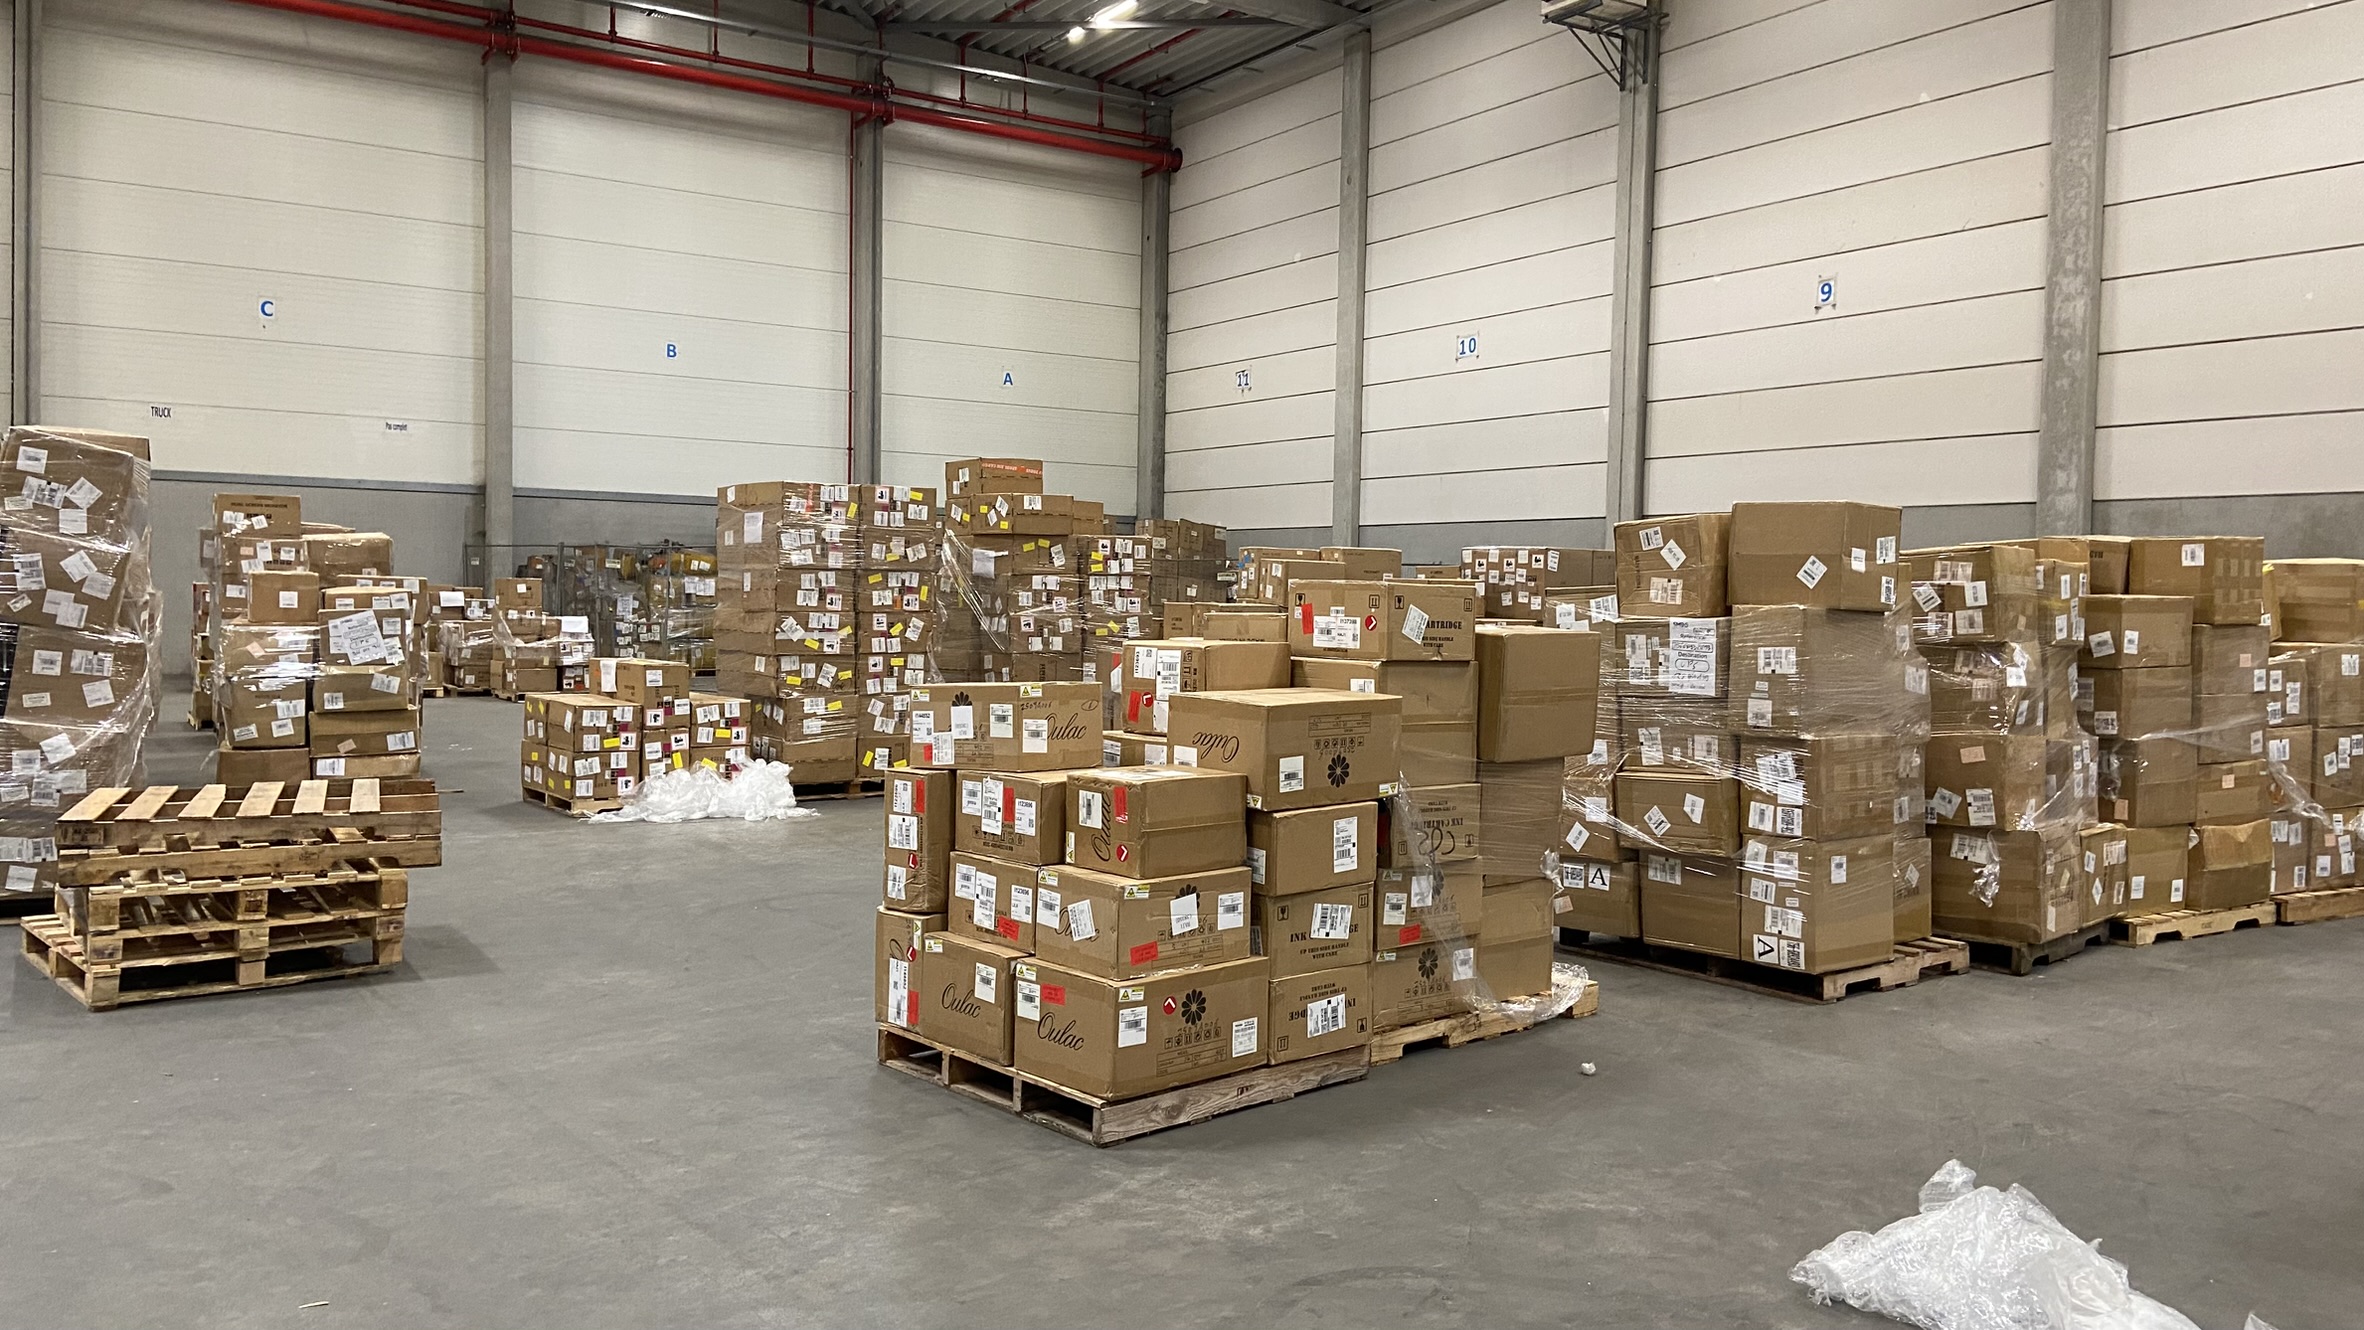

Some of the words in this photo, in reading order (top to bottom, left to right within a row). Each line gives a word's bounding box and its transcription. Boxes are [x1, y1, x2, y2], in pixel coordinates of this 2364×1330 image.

[1820, 282, 1833, 302] 9
[260, 300, 274, 317] C
[666, 343, 677, 358] B
[1459, 338, 1477, 355] 10
[1003, 372, 1014, 386] A
[1237, 373, 1250, 387] 11
[150, 406, 172, 418] TRUCK
[1425, 620, 1462, 629] ARTRIDGE
[1191, 731, 1240, 763] Oulac
[1589, 867, 1608, 887] A
[1290, 932, 1307, 943] INK
[1756, 938, 1776, 959] A
[941, 982, 981, 1018] Oulac
[1037, 1011, 1085, 1051] Oulac
